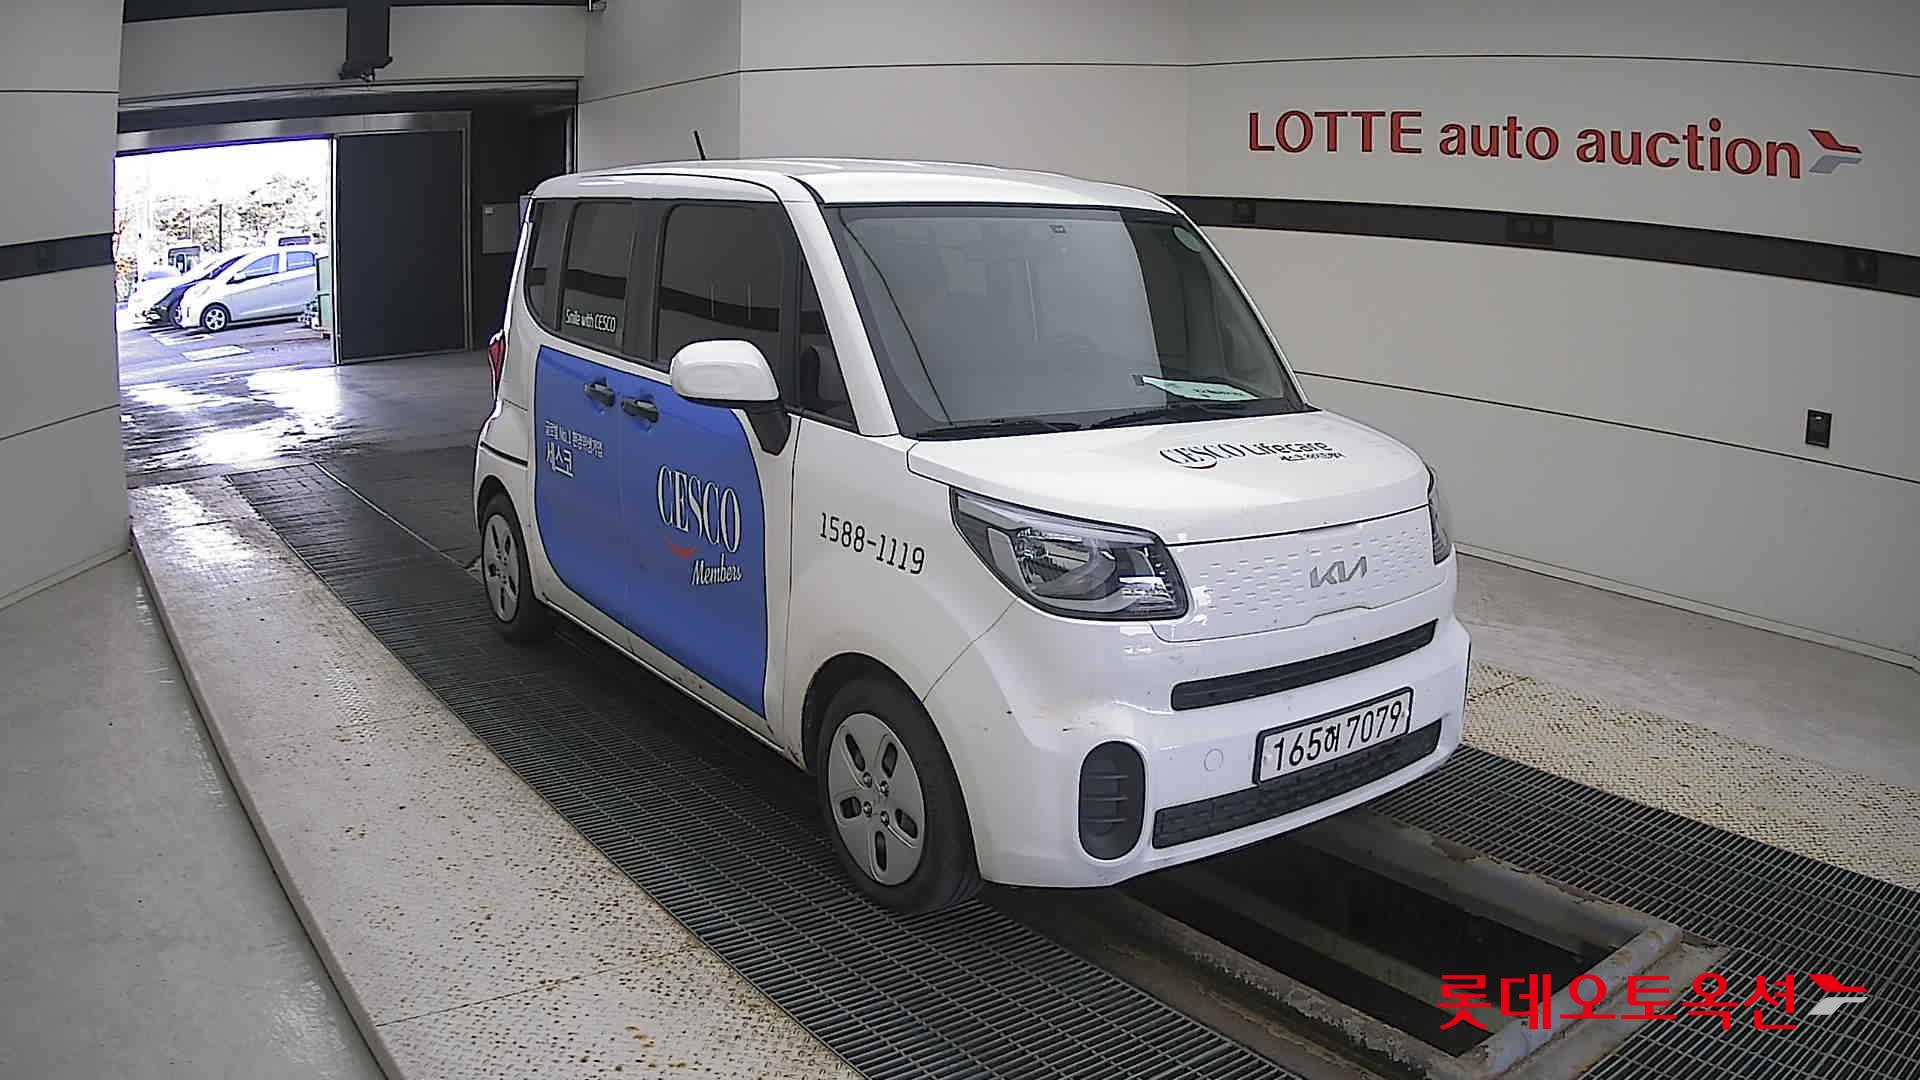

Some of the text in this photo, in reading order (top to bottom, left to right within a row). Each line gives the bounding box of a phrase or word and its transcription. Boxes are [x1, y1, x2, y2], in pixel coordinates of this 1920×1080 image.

[1247, 110, 1801, 179] LOTTE auto auction
[594, 313, 616, 333] CESCO
[1159, 442, 1333, 463] CESCO Lifecare
[657, 465, 741, 553] CESCO
[819, 512, 926, 575] 1588-1119
[691, 553, 743, 585] Members
[1310, 556, 1367, 588] KIA
[1273, 700, 1403, 771] 165허 7079
